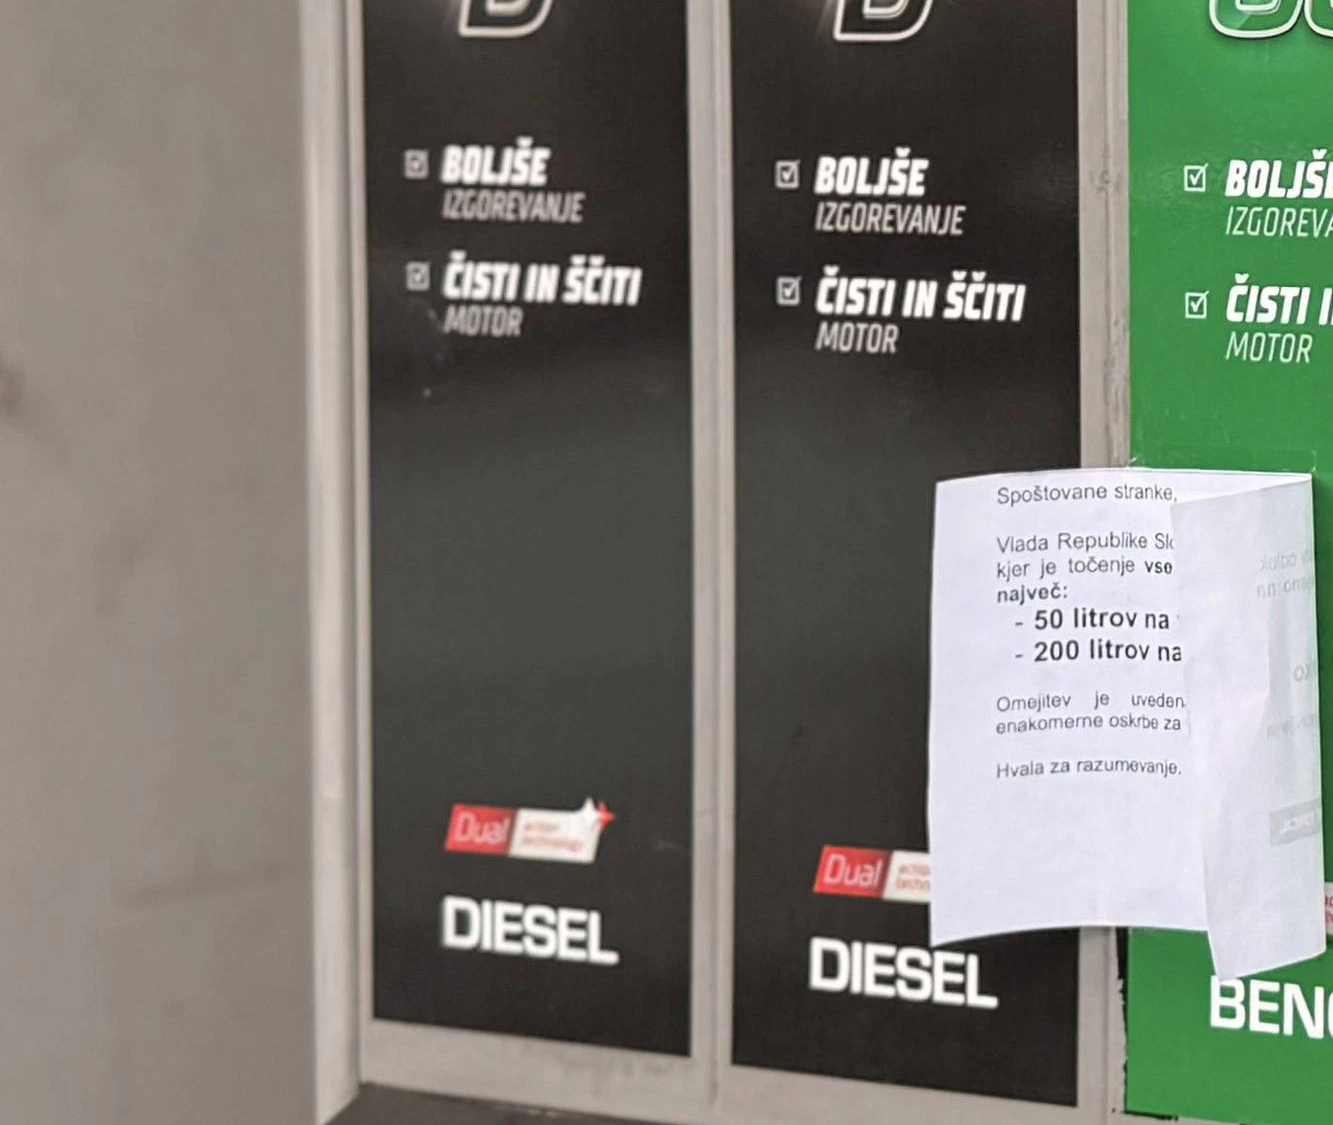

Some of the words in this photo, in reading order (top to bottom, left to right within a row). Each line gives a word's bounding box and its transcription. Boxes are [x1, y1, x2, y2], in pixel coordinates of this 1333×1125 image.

[440, 137, 551, 185] BOLJŠE
[814, 146, 928, 197] BOLJŠE
[443, 189, 586, 224] IZGOREVANJE
[815, 202, 966, 236] IZGOREVANJE
[442, 250, 522, 301] ČISTI
[524, 265, 560, 303] IN
[562, 255, 642, 306] ŠČITI
[815, 265, 896, 317] ČISTI
[902, 279, 938, 319] IN
[943, 271, 1026, 322] ŠČITI
[1225, 273, 1311, 324] ČISTI
[444, 305, 523, 337] MOTOR
[815, 321, 898, 354] MOTOR
[1225, 331, 1313, 363] MOTOR
[997, 483, 1108, 505] Spoštovane
[1114, 485, 1178, 504] stranke,
[997, 534, 1049, 554] Vlada
[1057, 531, 1148, 552] Republike
[996, 558, 1030, 582] kjer
[1040, 558, 1057, 579] je
[1068, 555, 1135, 577] točenje
[997, 582, 1068, 606] največ:
[1034, 609, 1064, 631] 50
[1073, 607, 1137, 630] litrov
[1145, 613, 1170, 630] na
[1033, 640, 1079, 663] 200
[1089, 639, 1149, 661] litrov
[1158, 643, 1182, 662] na
[997, 692, 1071, 713] Omejitev
[1095, 690, 1110, 709] je
[996, 715, 1103, 735] enakomerne
[1109, 714, 1159, 731] oskrbe
[1164, 718, 1182, 732] za
[997, 758, 1045, 780] Hvala
[1050, 760, 1071, 775] za
[1076, 758, 1183, 778] razumevanje.
[455, 811, 511, 845] Dual
[823, 853, 883, 887] Dual
[442, 896, 619, 966] DIESEL
[810, 936, 998, 1010] DIESEL
